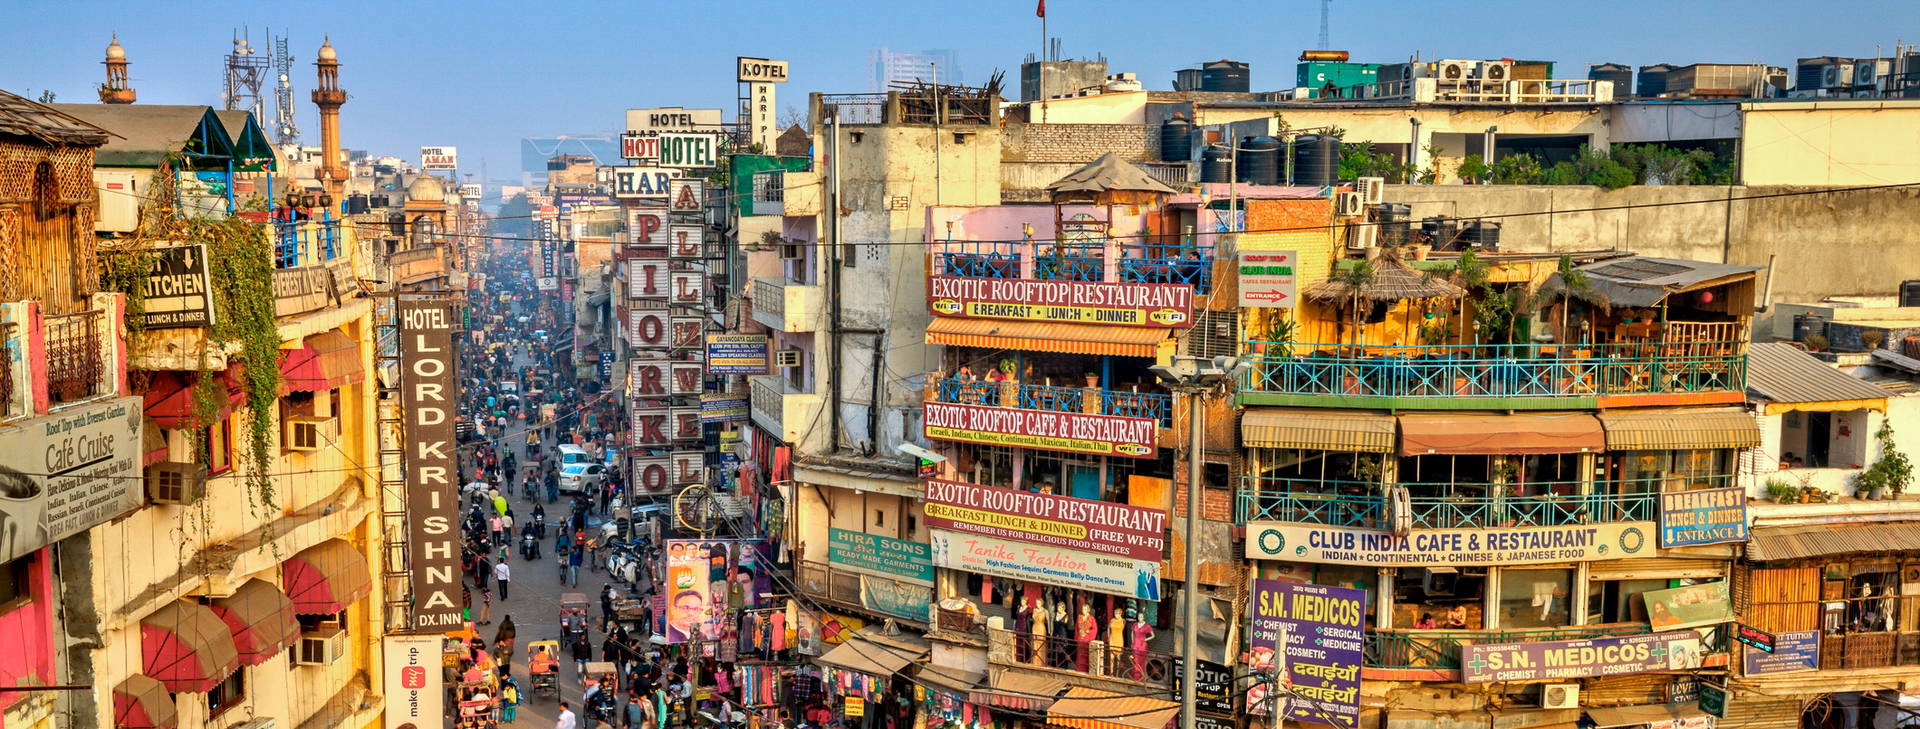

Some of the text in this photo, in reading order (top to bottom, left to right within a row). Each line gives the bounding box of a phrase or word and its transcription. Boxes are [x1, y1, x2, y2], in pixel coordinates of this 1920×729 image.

[743, 64, 785, 77] HOTEL
[651, 114, 695, 126] HOTEL
[425, 156, 454, 164] AMAN
[660, 136, 715, 165] HOTEL
[617, 172, 680, 195] HAR
[1240, 265, 1292, 275] CLUB INDIA
[932, 278, 1189, 307] EXOTIC ROOFTOP RESTAURANT
[147, 311, 206, 324] LUNCH & DINNER
[404, 309, 449, 329] HOTEL
[1046, 307, 1081, 321] LUNCH
[1095, 309, 1137, 323] DINNER
[46, 404, 126, 436] Roof Top with Everest Garden
[926, 404, 1153, 444] EXOTIC ROOFTOP CAFE & RESTAURANT
[930, 427, 951, 437] Israeli,
[952, 430, 973, 440] Indian,
[974, 432, 999, 443] Chinese,
[1001, 435, 1038, 446] Continental,
[46, 432, 114, 473] Café Cruise
[413, 334, 455, 609] LORD KRISHNA
[927, 480, 1166, 534] EXOTIC ROOFTOP RESTAURANT
[1665, 490, 1742, 511] BREAKFAST
[928, 504, 1083, 537] BREAKFAST LUNCH & DINNER
[1665, 509, 1744, 528] LUNCH & DINNER
[838, 532, 925, 555] HIRA SONS
[953, 521, 996, 535] REMEMBER
[1008, 530, 1024, 539] FOR
[1025, 532, 1067, 546] DELICIOUS
[1068, 538, 1091, 549] FOOD
[1091, 543, 1130, 555] SERVICES
[1089, 528, 1164, 552] (FREE WI-FI)
[1309, 529, 1597, 551] CLUB INDIA CAFE & RESTAURANT
[1677, 527, 1735, 543] ENTRANCE
[837, 549, 925, 572] READY MADE GARMENTS
[964, 540, 1088, 572] Tanika Fashion
[1321, 549, 1585, 562] INDIAN CONTINENTAL CHINESE & JAPANESE FOOD
[986, 559, 1126, 586] High Fashion Sequins Garments Belly Dance Dresses
[1259, 590, 1361, 627] S.N. MEDICOS
[1263, 619, 1298, 633] CHEMIST
[1323, 626, 1362, 641] SERGICAL
[1785, 632, 1813, 641] TUITION
[1262, 630, 1305, 645] PHAMACY
[1322, 638, 1361, 652] MEDICINE
[1286, 646, 1327, 660] COSMETIC
[1487, 642, 1650, 670] S.N. MEDICOS
[408, 647, 424, 717] make my trip
[1496, 663, 1643, 681] CHEMIST PHARMACY COSMETIC
